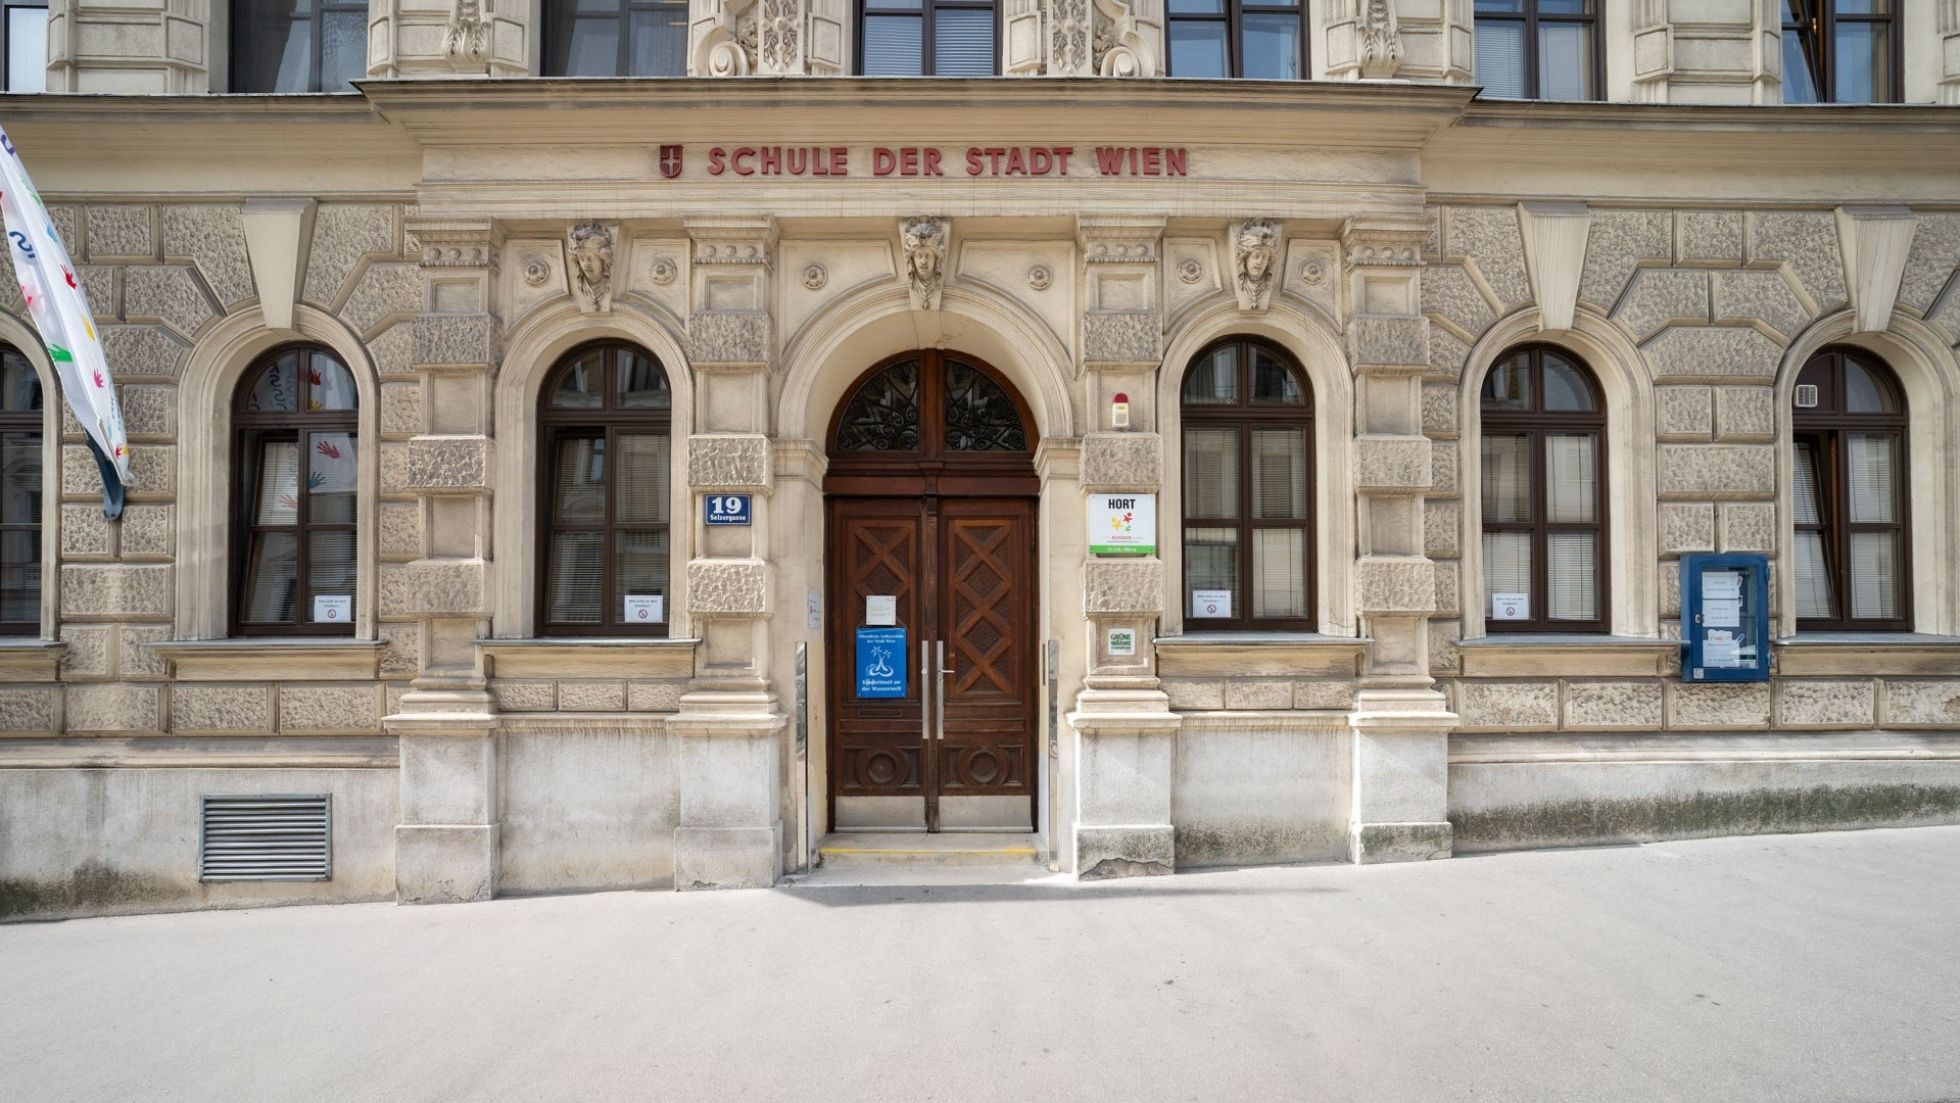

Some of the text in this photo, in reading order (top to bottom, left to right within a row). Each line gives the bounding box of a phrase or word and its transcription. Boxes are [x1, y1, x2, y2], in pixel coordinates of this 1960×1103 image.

[707, 146, 1187, 176] SCHULE DER STADT WIEN
[711, 497, 742, 514] 19
[1108, 498, 1136, 510] HORT
